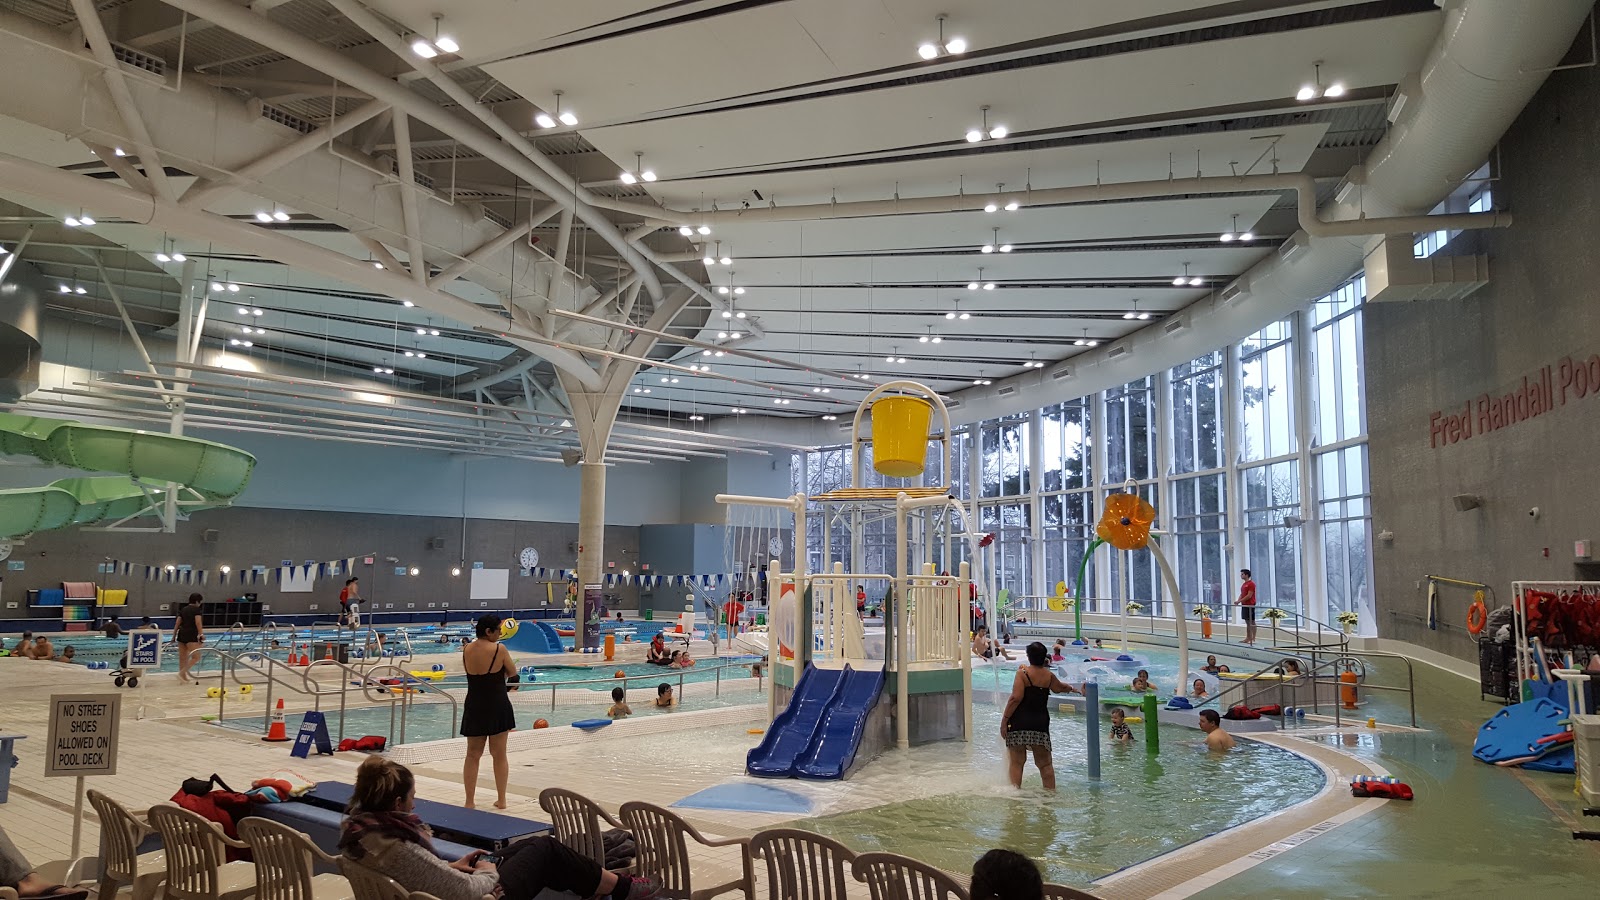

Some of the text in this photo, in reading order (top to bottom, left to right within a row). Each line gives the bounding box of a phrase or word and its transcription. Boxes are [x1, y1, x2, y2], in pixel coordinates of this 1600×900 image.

[1430, 400, 1472, 449] Fred
[1478, 365, 1554, 435] Randall
[63, 704, 107, 717] NO STREET
[70, 720, 97, 733] SHOES
[57, 736, 108, 749] ALLOWED ON
[58, 752, 104, 766] POOL DECK
